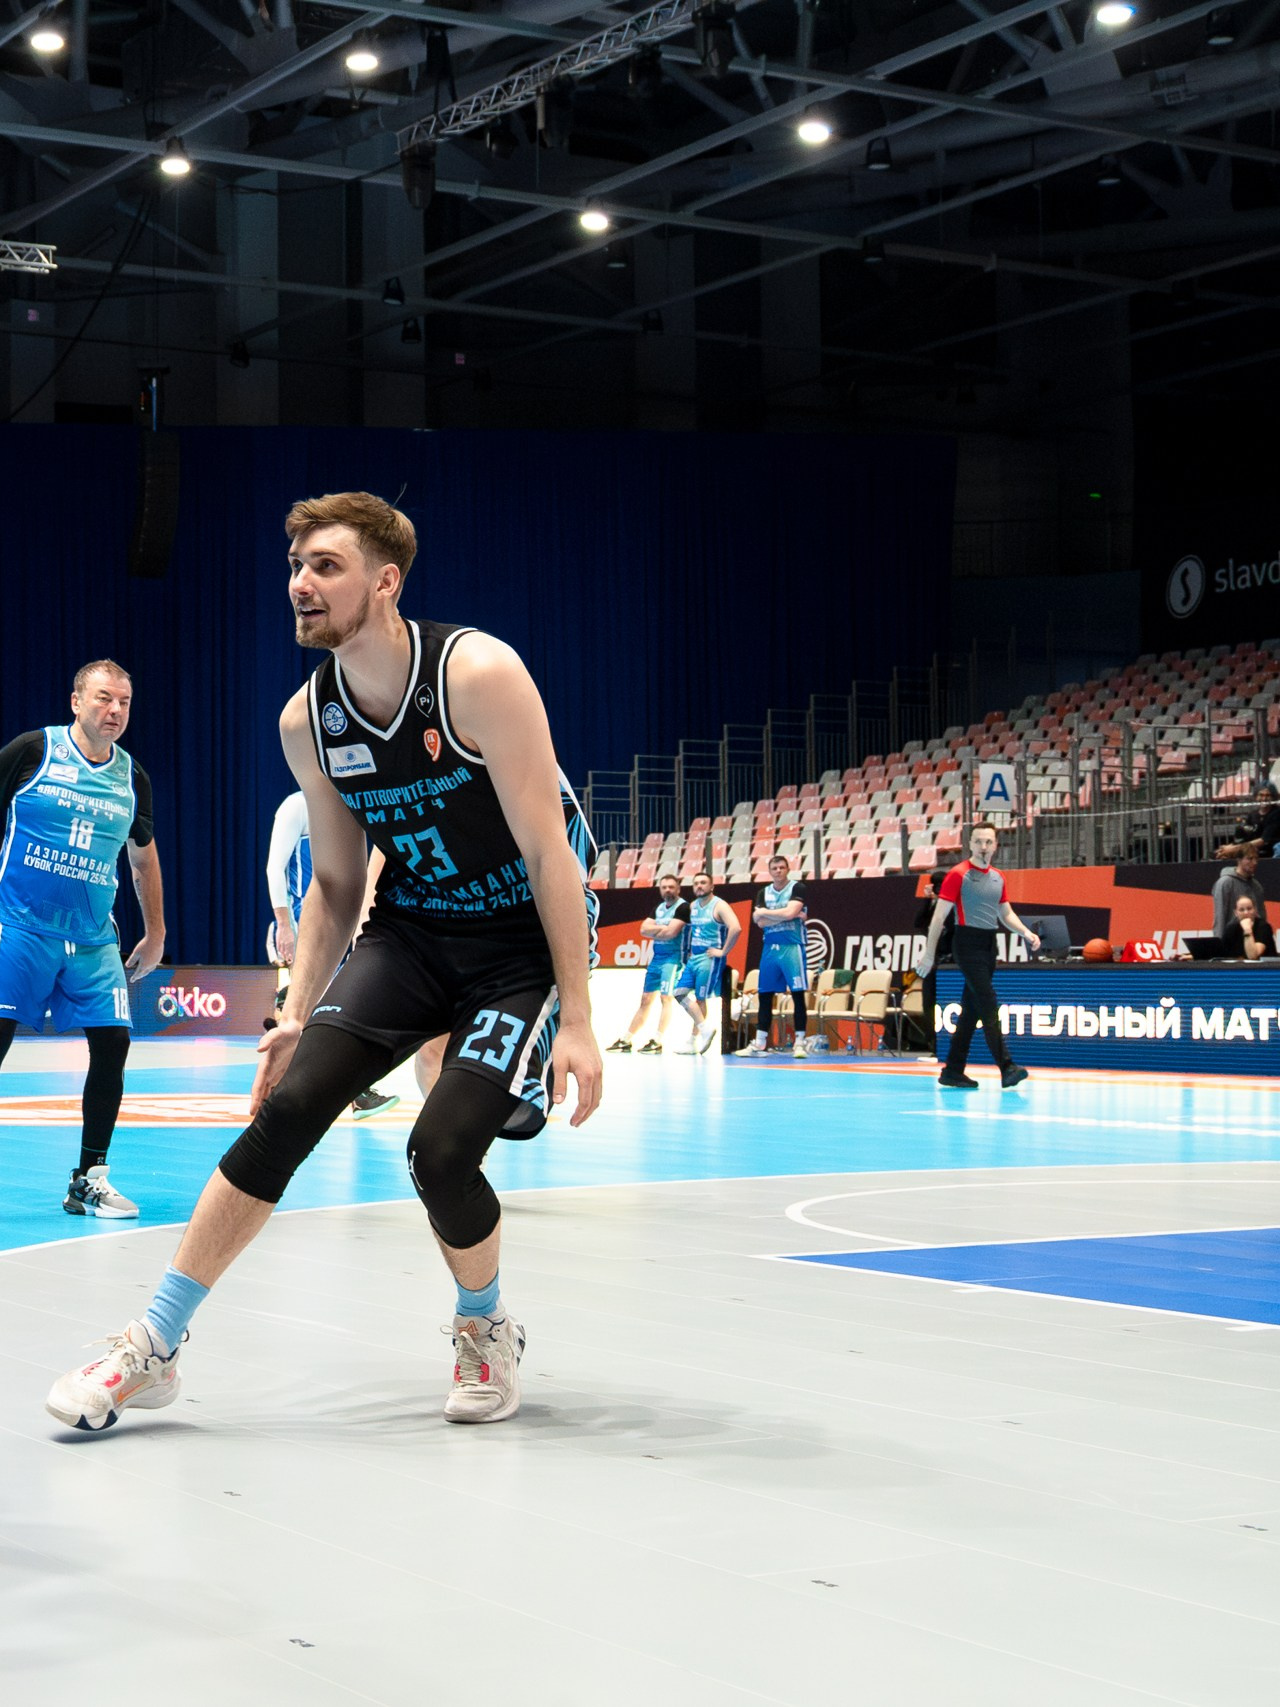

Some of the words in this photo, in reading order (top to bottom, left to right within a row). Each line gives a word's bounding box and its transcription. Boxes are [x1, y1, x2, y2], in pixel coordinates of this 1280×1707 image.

[57, 799, 113, 821] МАТЧ
[365, 797, 446, 824] МАТЧ
[69, 817, 96, 851] 18
[23, 854, 52, 873] КУБОК
[53, 863, 89, 881] РОССИИ
[391, 822, 460, 883] 23
[112, 987, 130, 1019] 18
[1191, 1006, 1280, 1040] МАТ
[458, 1009, 526, 1073] 23
